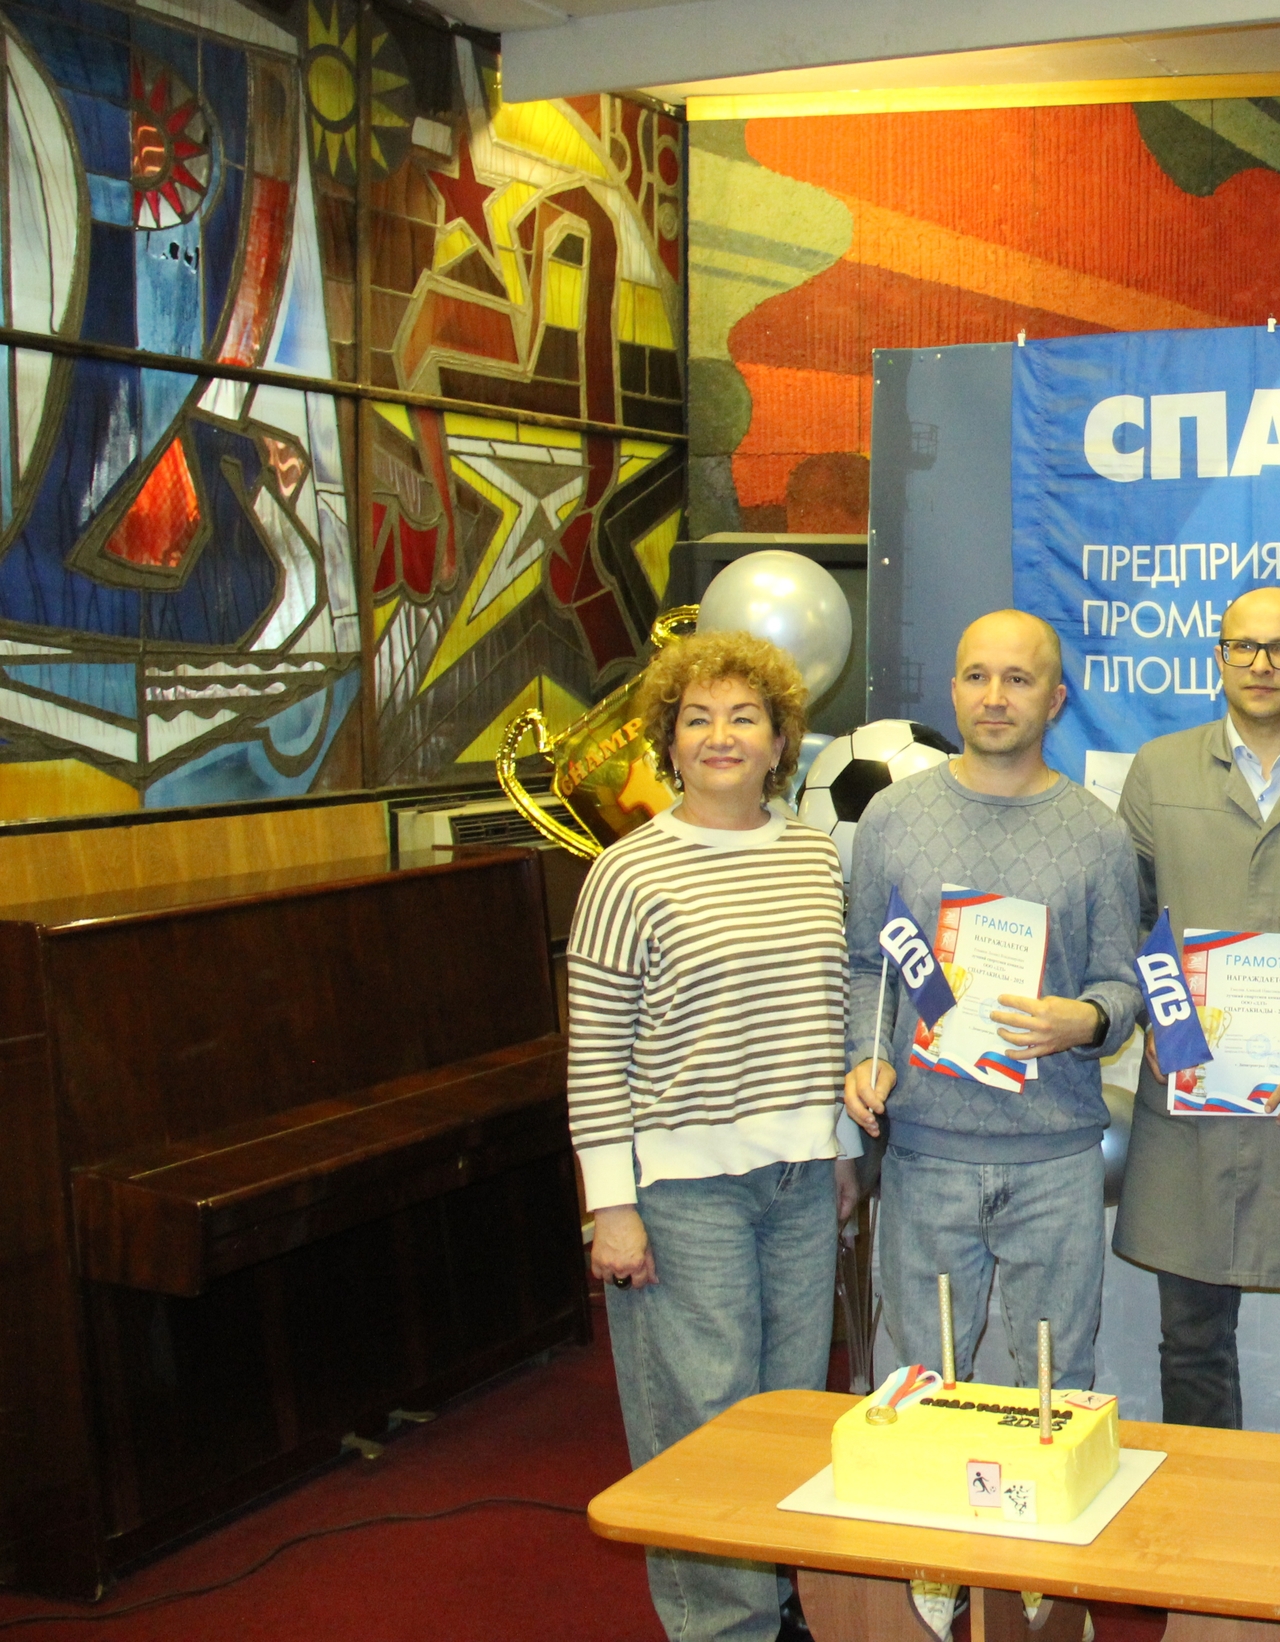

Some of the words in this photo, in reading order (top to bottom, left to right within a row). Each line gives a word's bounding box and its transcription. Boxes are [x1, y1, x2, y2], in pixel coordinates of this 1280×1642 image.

[974, 914, 1033, 938] ГРАМОТА
[974, 934, 1029, 953] НАГРАЖДАЕТСЯ
[1223, 1006, 1273, 1014] СПАРТАКИАДЫ
